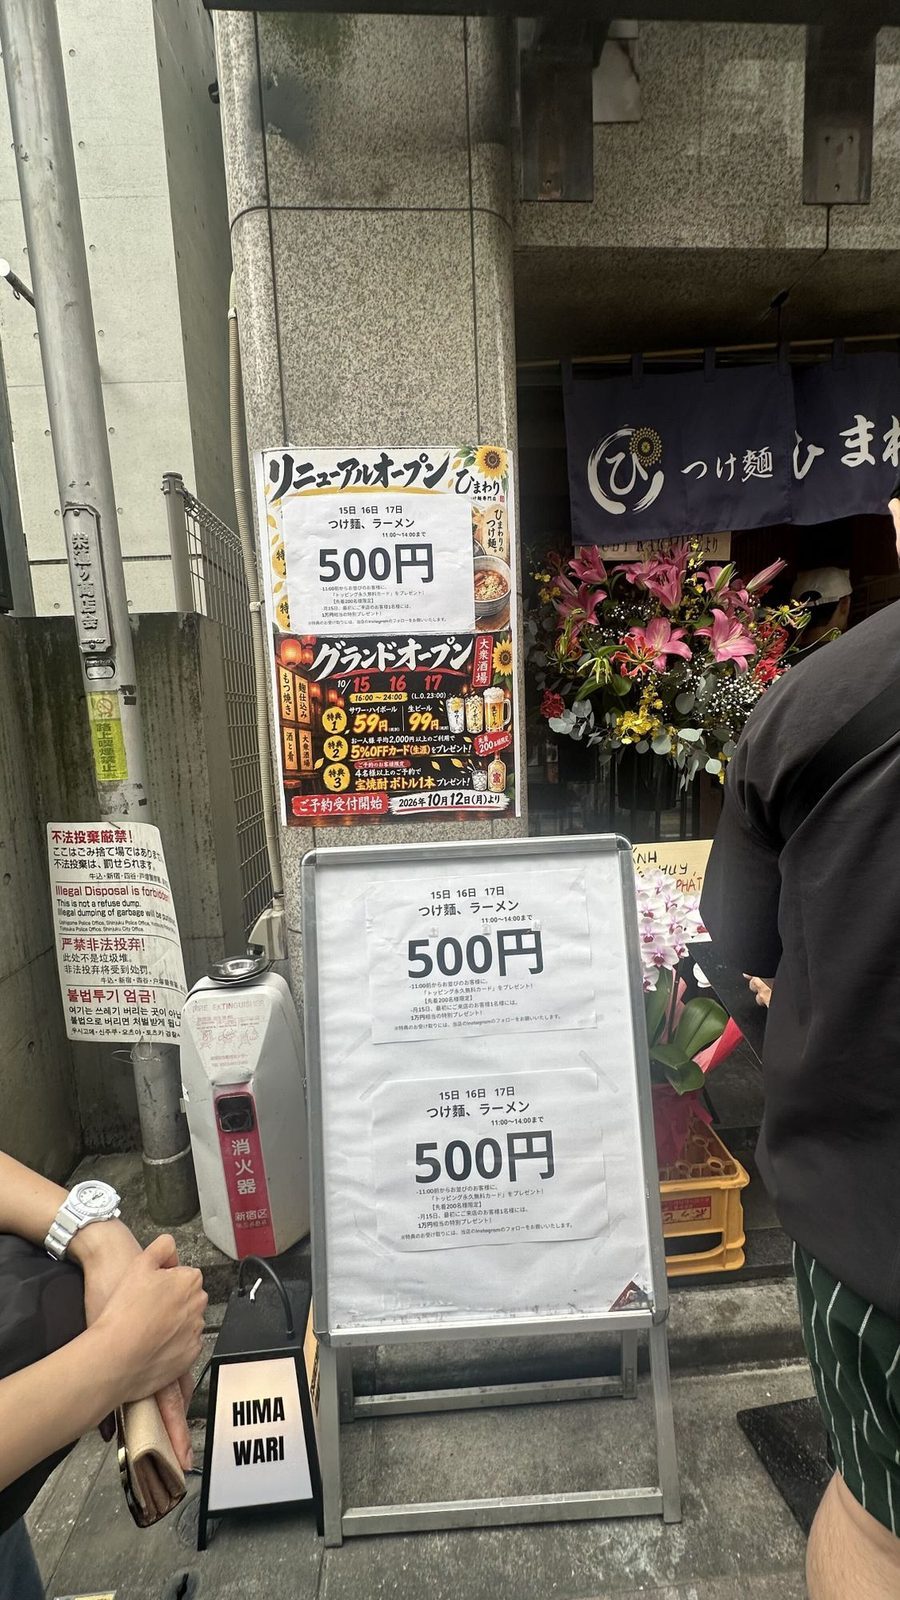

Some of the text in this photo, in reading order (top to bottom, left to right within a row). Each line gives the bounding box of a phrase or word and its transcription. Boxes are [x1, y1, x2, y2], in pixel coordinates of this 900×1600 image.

[269, 452, 450, 504] リニューアルオープン
[455, 468, 500, 496] ひまわり
[318, 543, 434, 584] 500円
[308, 636, 473, 682] グランドオープン
[475, 638, 490, 684] 大衆酒場
[353, 677, 371, 692] 15
[390, 676, 407, 692] 16
[425, 674, 443, 691] 17
[327, 712, 342, 721] 特典
[353, 714, 388, 733] 59円
[409, 713, 440, 732] 99円
[328, 741, 343, 749] 特典
[328, 768, 345, 777] 特典
[299, 796, 383, 813] ご予約受付開始
[51, 830, 133, 844] 不法投棄厳禁!
[56, 886, 82, 897] Illegal
[85, 886, 128, 897] Disposal
[132, 886, 139, 895] is
[431, 886, 504, 899] 15日 16日 17日
[57, 899, 70, 907] This
[122, 899, 141, 909] dump.
[58, 909, 76, 917] Illegal
[77, 909, 106, 918] dumping
[108, 908, 114, 916] of
[117, 909, 144, 918] garbage
[62, 938, 145, 951] 严禁非法投弃!
[407, 928, 544, 979] 500円
[67, 989, 156, 1003] 불법투기 엄금!
[68, 1006, 92, 1015] 여기는
[95, 1006, 120, 1016] 쓰레기
[124, 1006, 148, 1016] 버리는
[151, 1008, 166, 1017] 곳이
[71, 1016, 102, 1025] 불법으로
[105, 1017, 130, 1026] 버리면
[133, 1017, 165, 1026] 처벌받게
[440, 1086, 515, 1100] 15日 16日 17日
[415, 1130, 555, 1184] 500円
[232, 1138, 256, 1194] 消火器
[235, 1209, 267, 1222] 新宿区
[232, 1396, 286, 1427] HIMA
[233, 1436, 284, 1466] WARI
